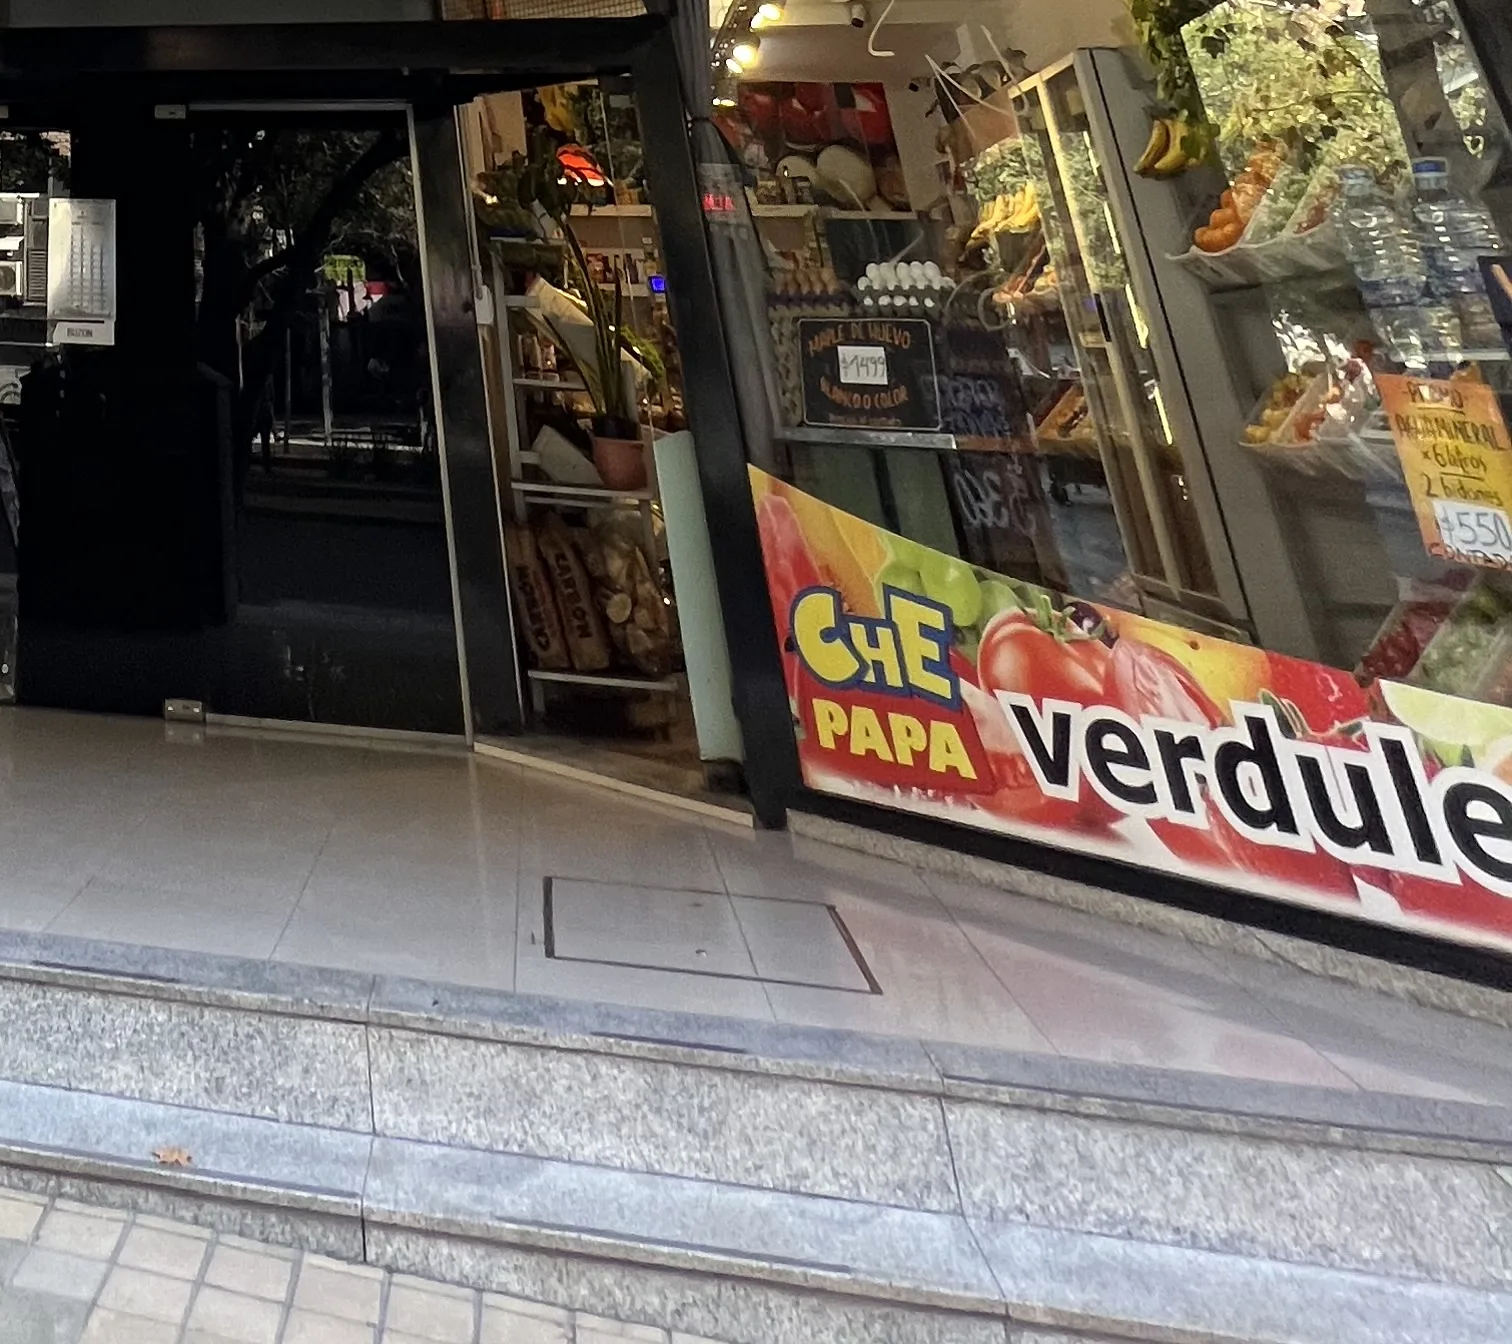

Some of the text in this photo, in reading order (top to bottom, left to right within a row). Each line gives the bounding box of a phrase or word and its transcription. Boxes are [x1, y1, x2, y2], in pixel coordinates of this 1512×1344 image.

[791, 585, 958, 709] CHE
[811, 697, 979, 781] PAPA
[1012, 702, 1512, 883] verdule
